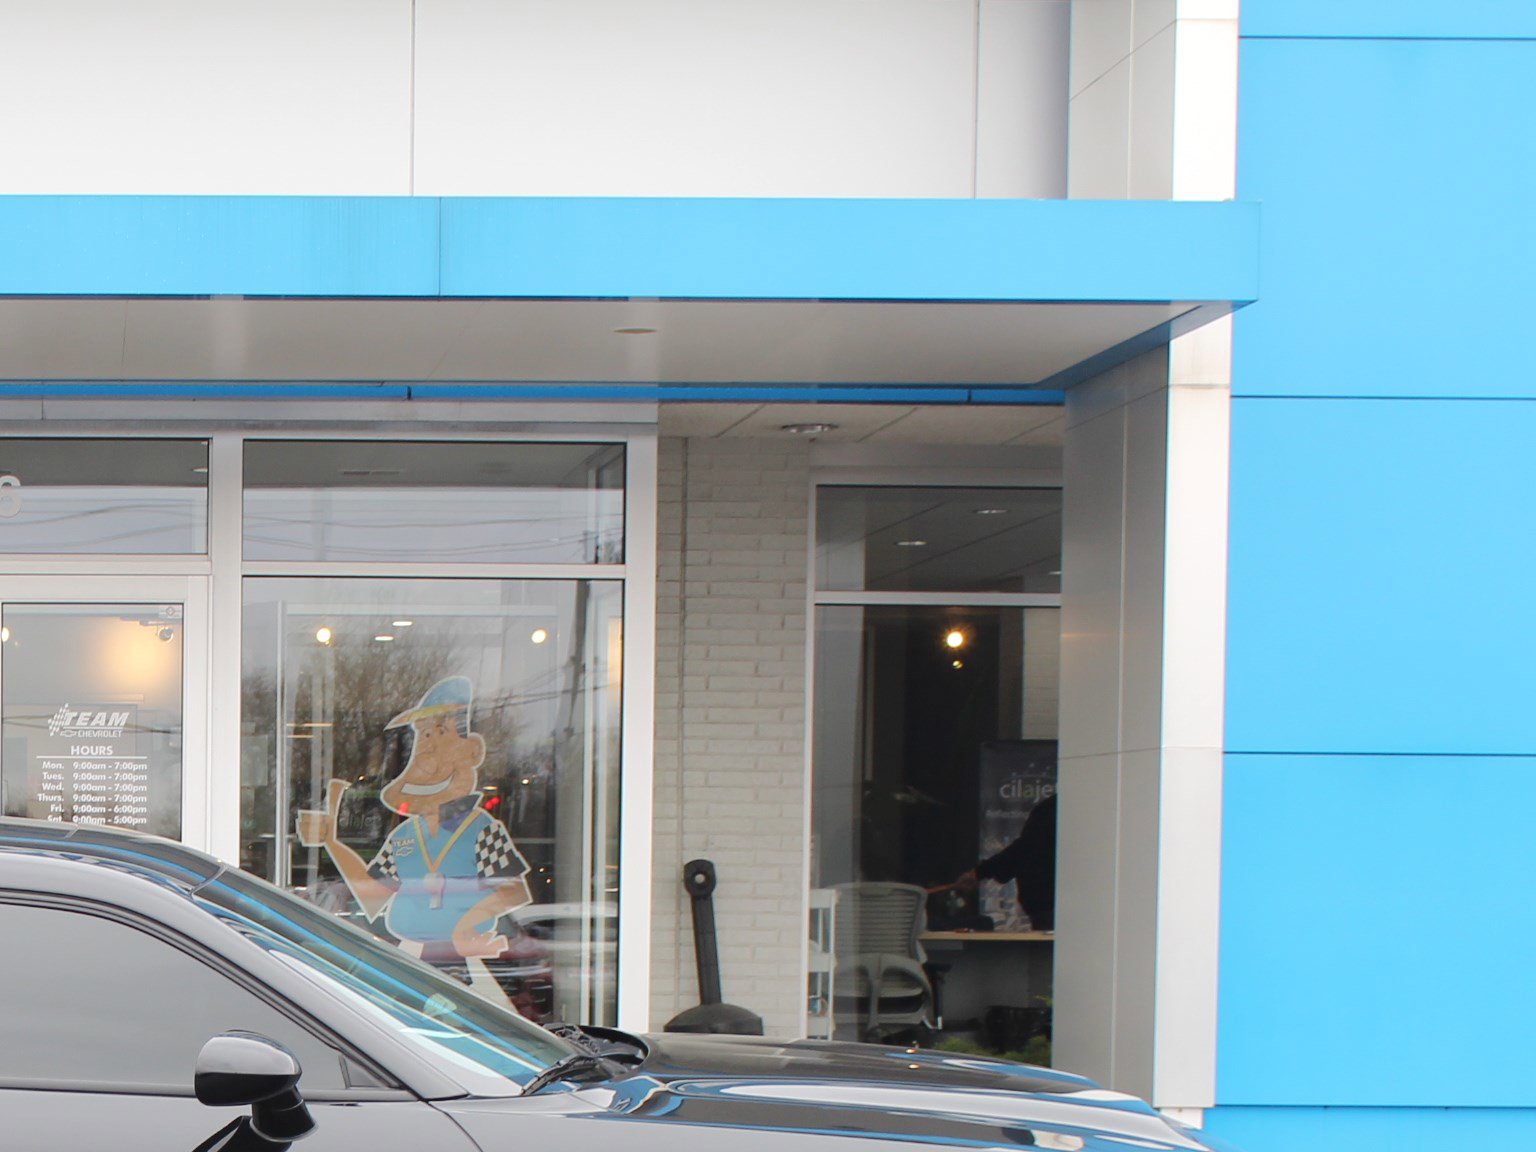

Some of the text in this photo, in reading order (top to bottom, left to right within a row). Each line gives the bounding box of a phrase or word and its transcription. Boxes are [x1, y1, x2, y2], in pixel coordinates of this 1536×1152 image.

[64, 711, 130, 726] TEAM
[78, 730, 123, 738] CHEVROLET
[70, 745, 114, 756] HOURS
[42, 761, 65, 770] Mon.
[72, 762, 106, 770] 9:00am
[113, 762, 148, 772] 7:00pm
[42, 771, 65, 780] Tues.
[72, 773, 106, 781] 9:00am
[113, 773, 148, 782] 7:00pm
[41, 782, 65, 791] Wed.
[72, 783, 106, 791] 9:00am
[113, 783, 148, 793] 7:00pm
[999, 778, 1056, 804] cilaje
[37, 793, 65, 802] Thurs.
[72, 794, 106, 802] 9:00am
[113, 794, 148, 804] 7:00pm
[50, 804, 65, 813] Fri.
[72, 805, 106, 813] 9:00am
[113, 805, 148, 814] 6:00pm
[113, 816, 148, 825] 5:00pm
[392, 838, 415, 847] TEAM
